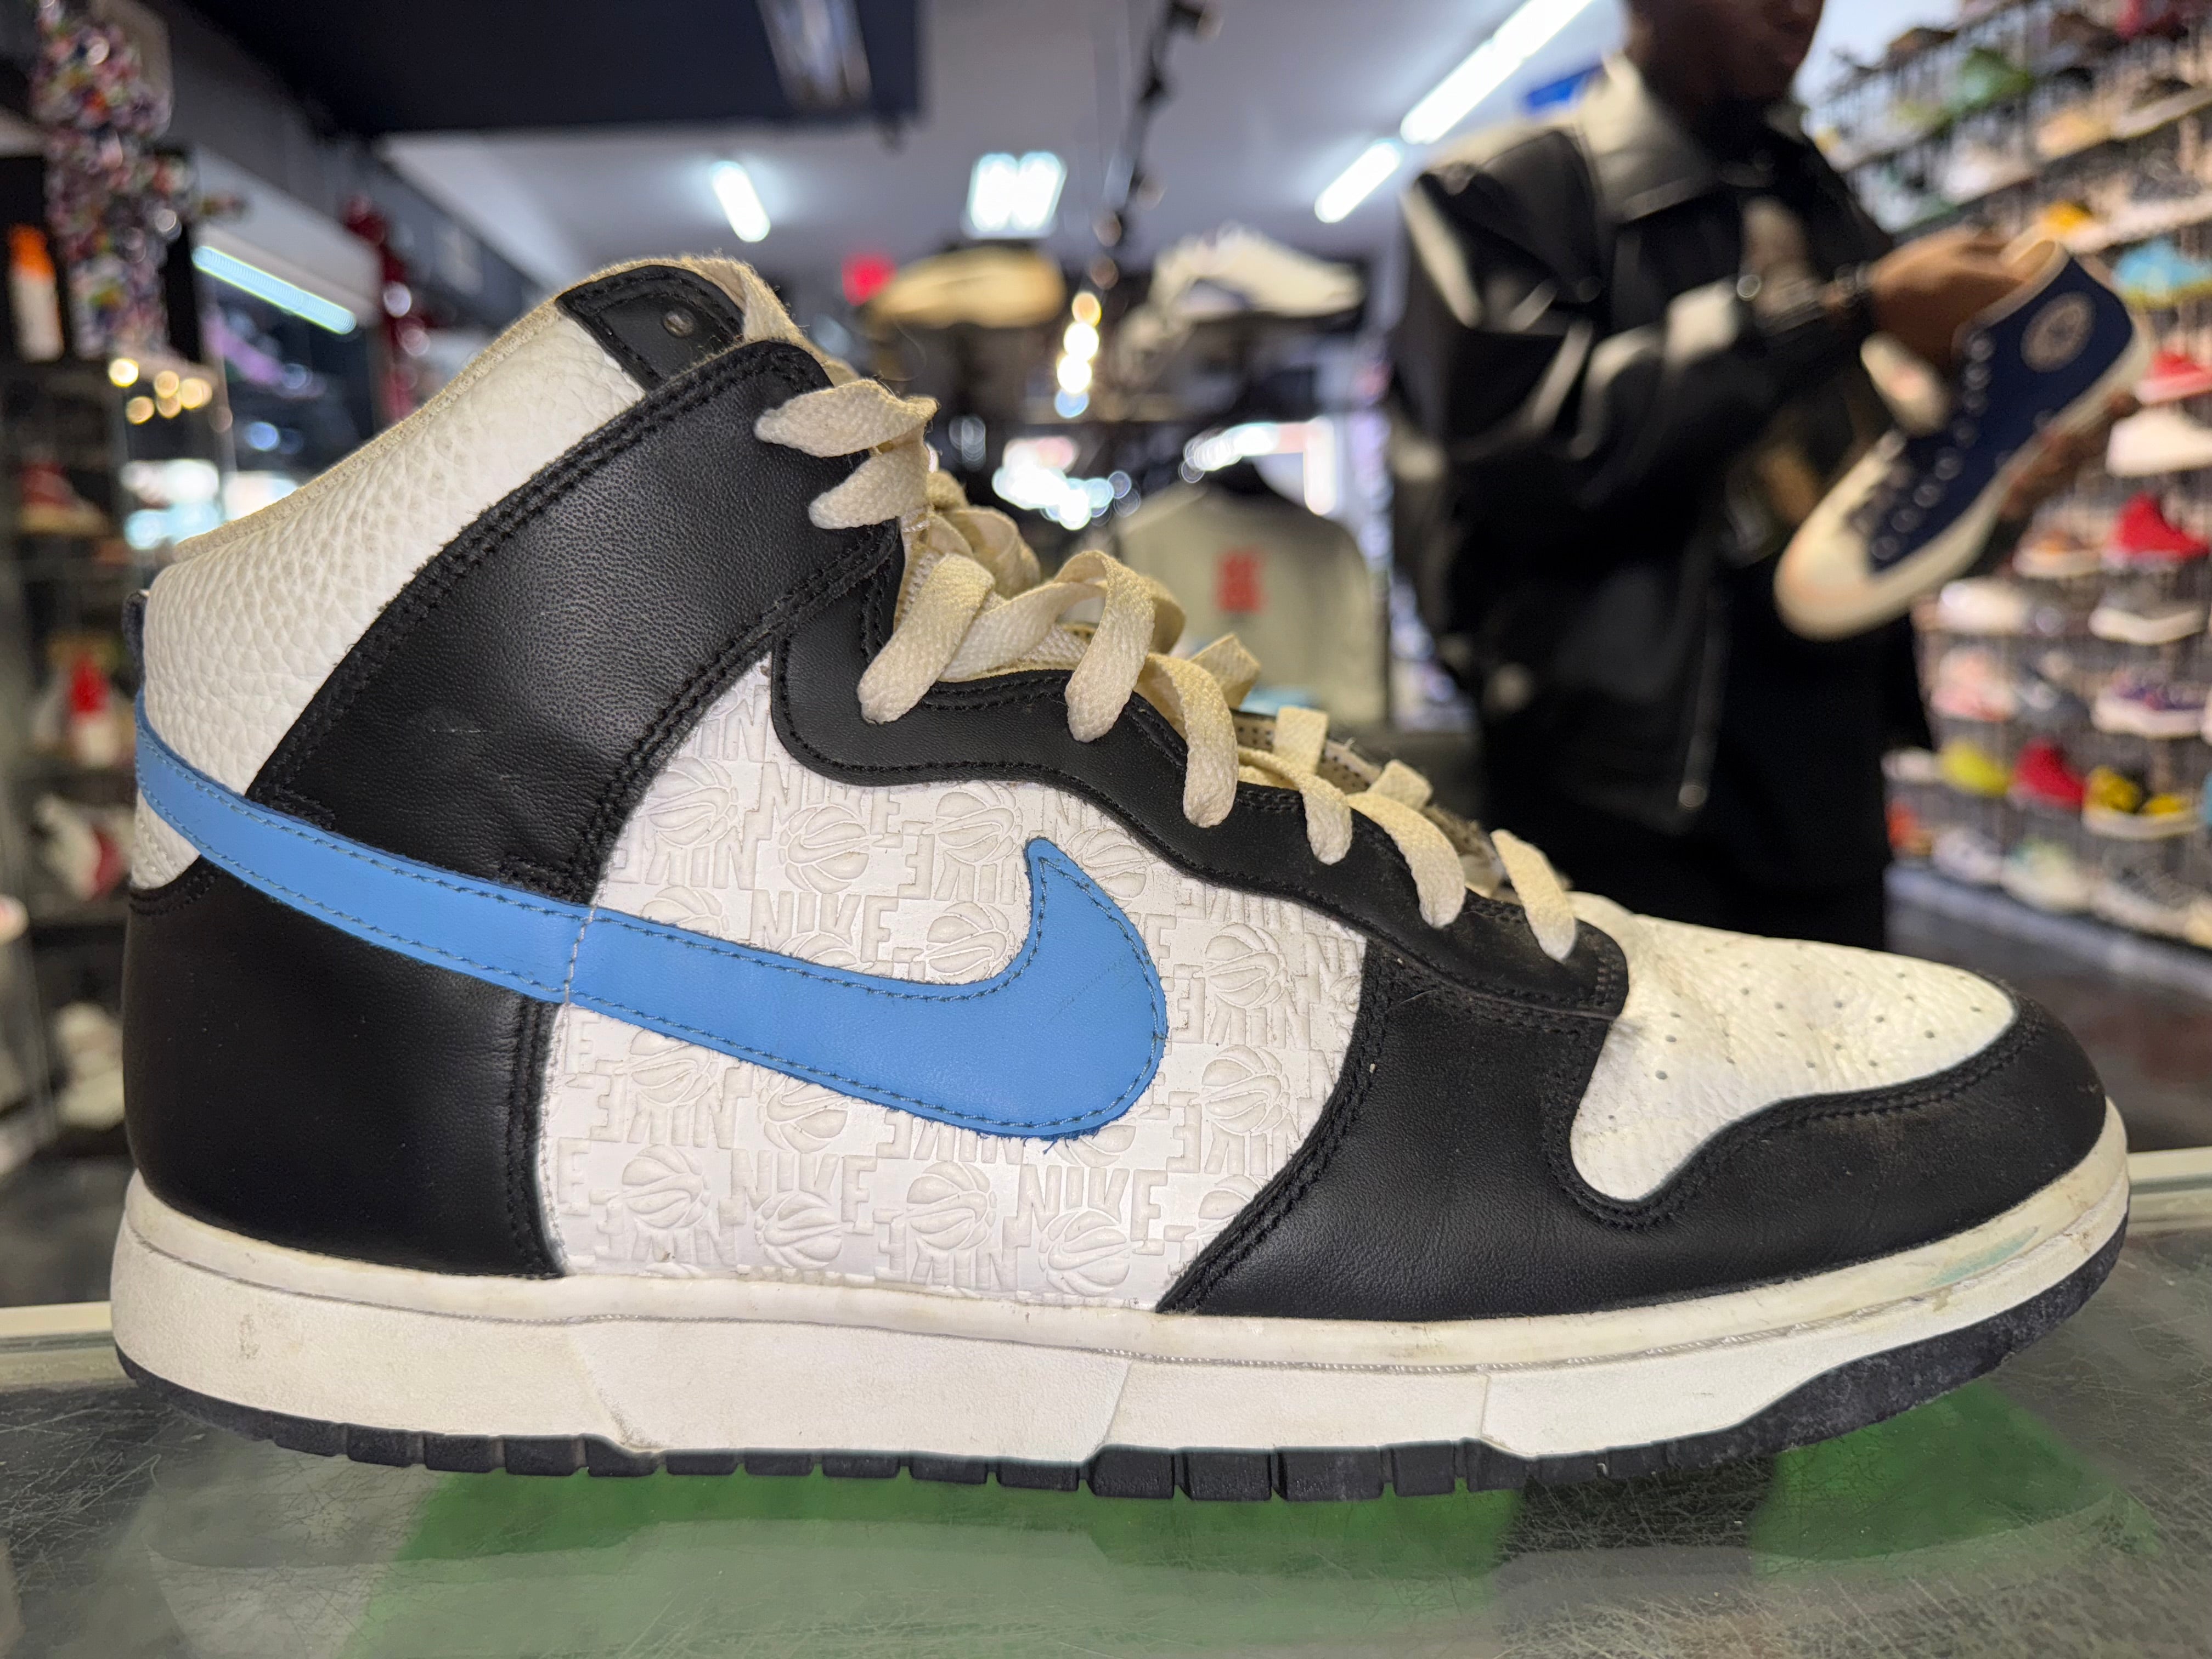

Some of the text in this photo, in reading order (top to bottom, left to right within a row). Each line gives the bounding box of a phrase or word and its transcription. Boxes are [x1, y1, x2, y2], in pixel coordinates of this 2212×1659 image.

[758, 762, 903, 849] NIKE
[751, 890, 898, 975] NIKE
[1172, 964, 1310, 1049] NIKE
[590, 1059, 738, 1148] NIKE
[590, 1189, 736, 1265] NIKE
[731, 1149, 877, 1238] NIKE
[1018, 1164, 1167, 1255] NIKE
[873, 1208, 1019, 1290] NIKE
